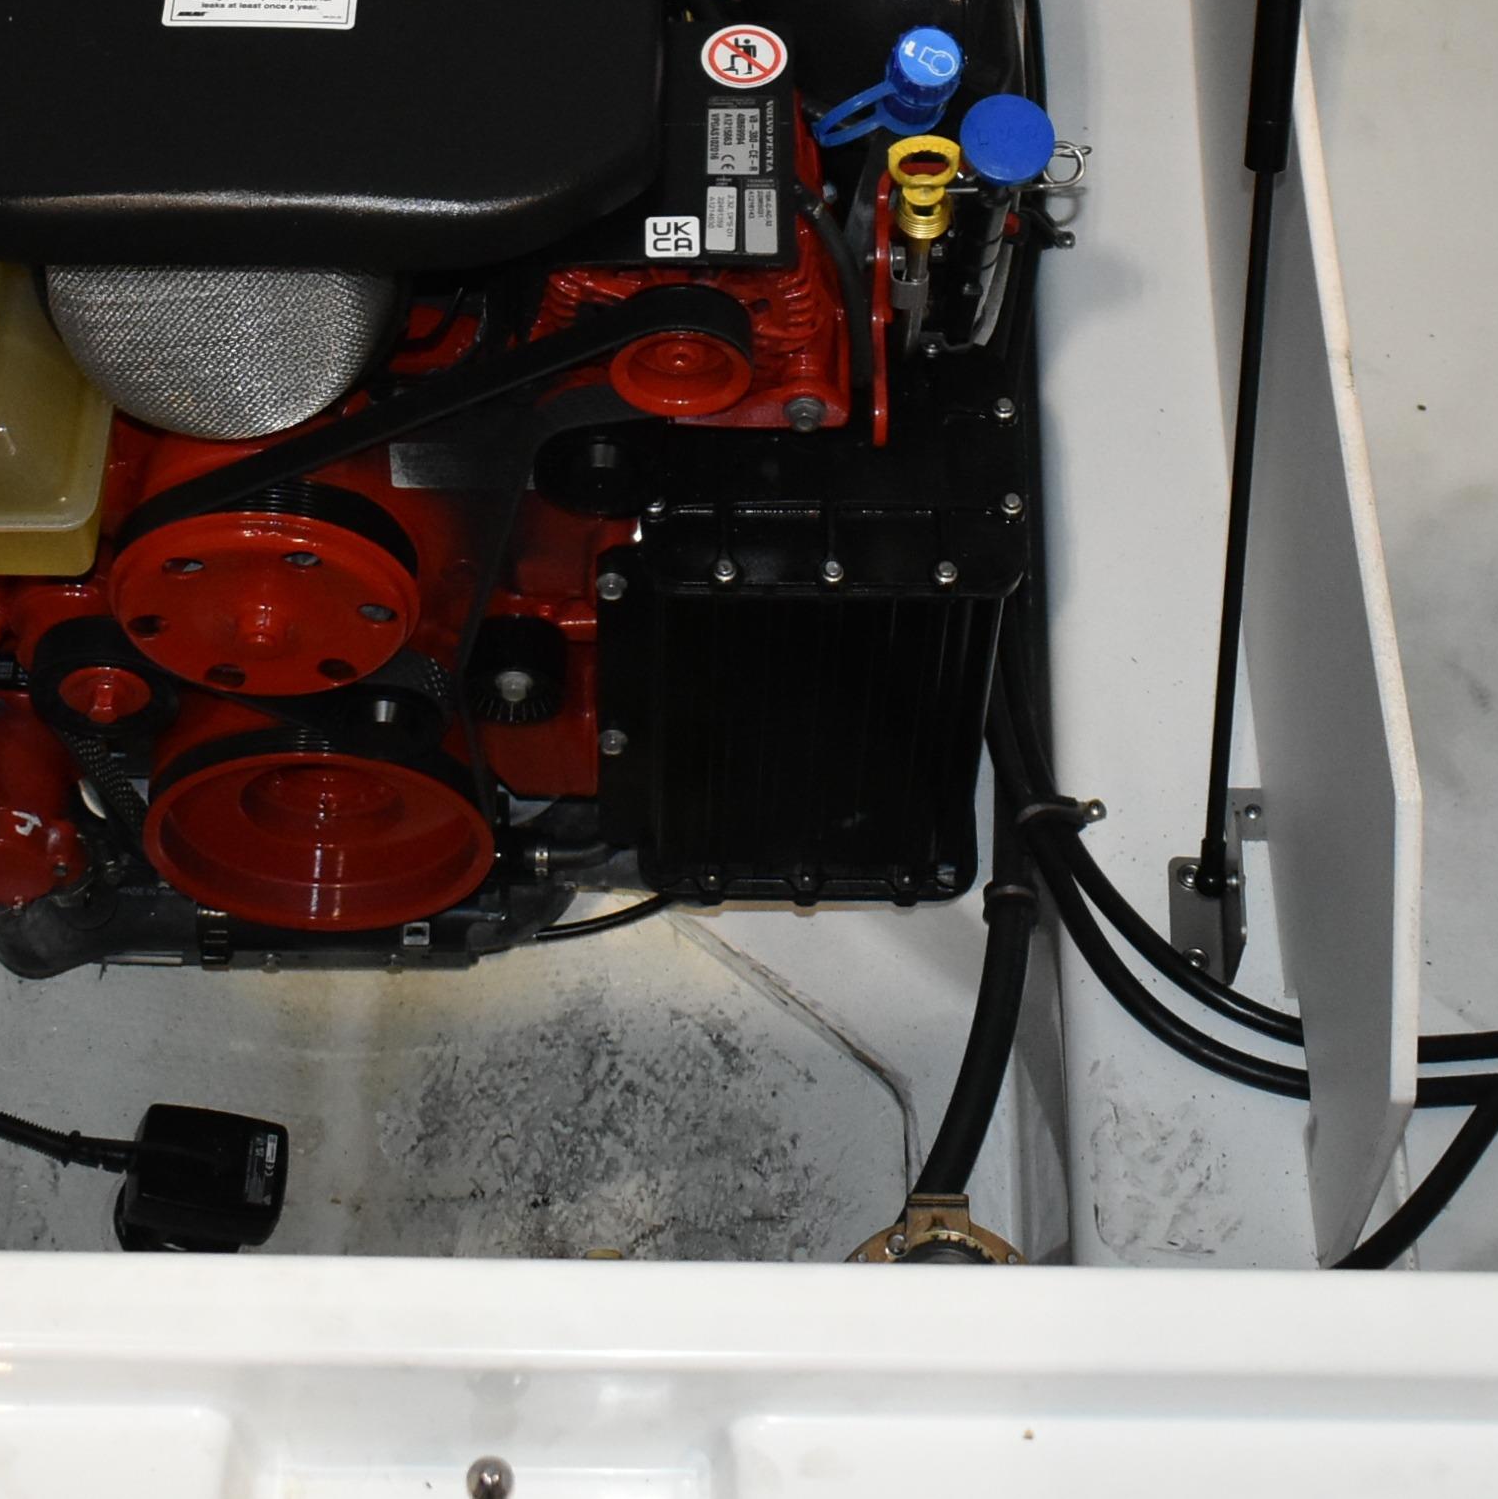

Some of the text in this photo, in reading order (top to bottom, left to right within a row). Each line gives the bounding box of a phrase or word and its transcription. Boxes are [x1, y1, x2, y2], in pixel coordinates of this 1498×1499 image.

[765, 99, 774, 172] VOLVO PENTA
[652, 221, 692, 236] UK
[652, 237, 693, 252] CA
